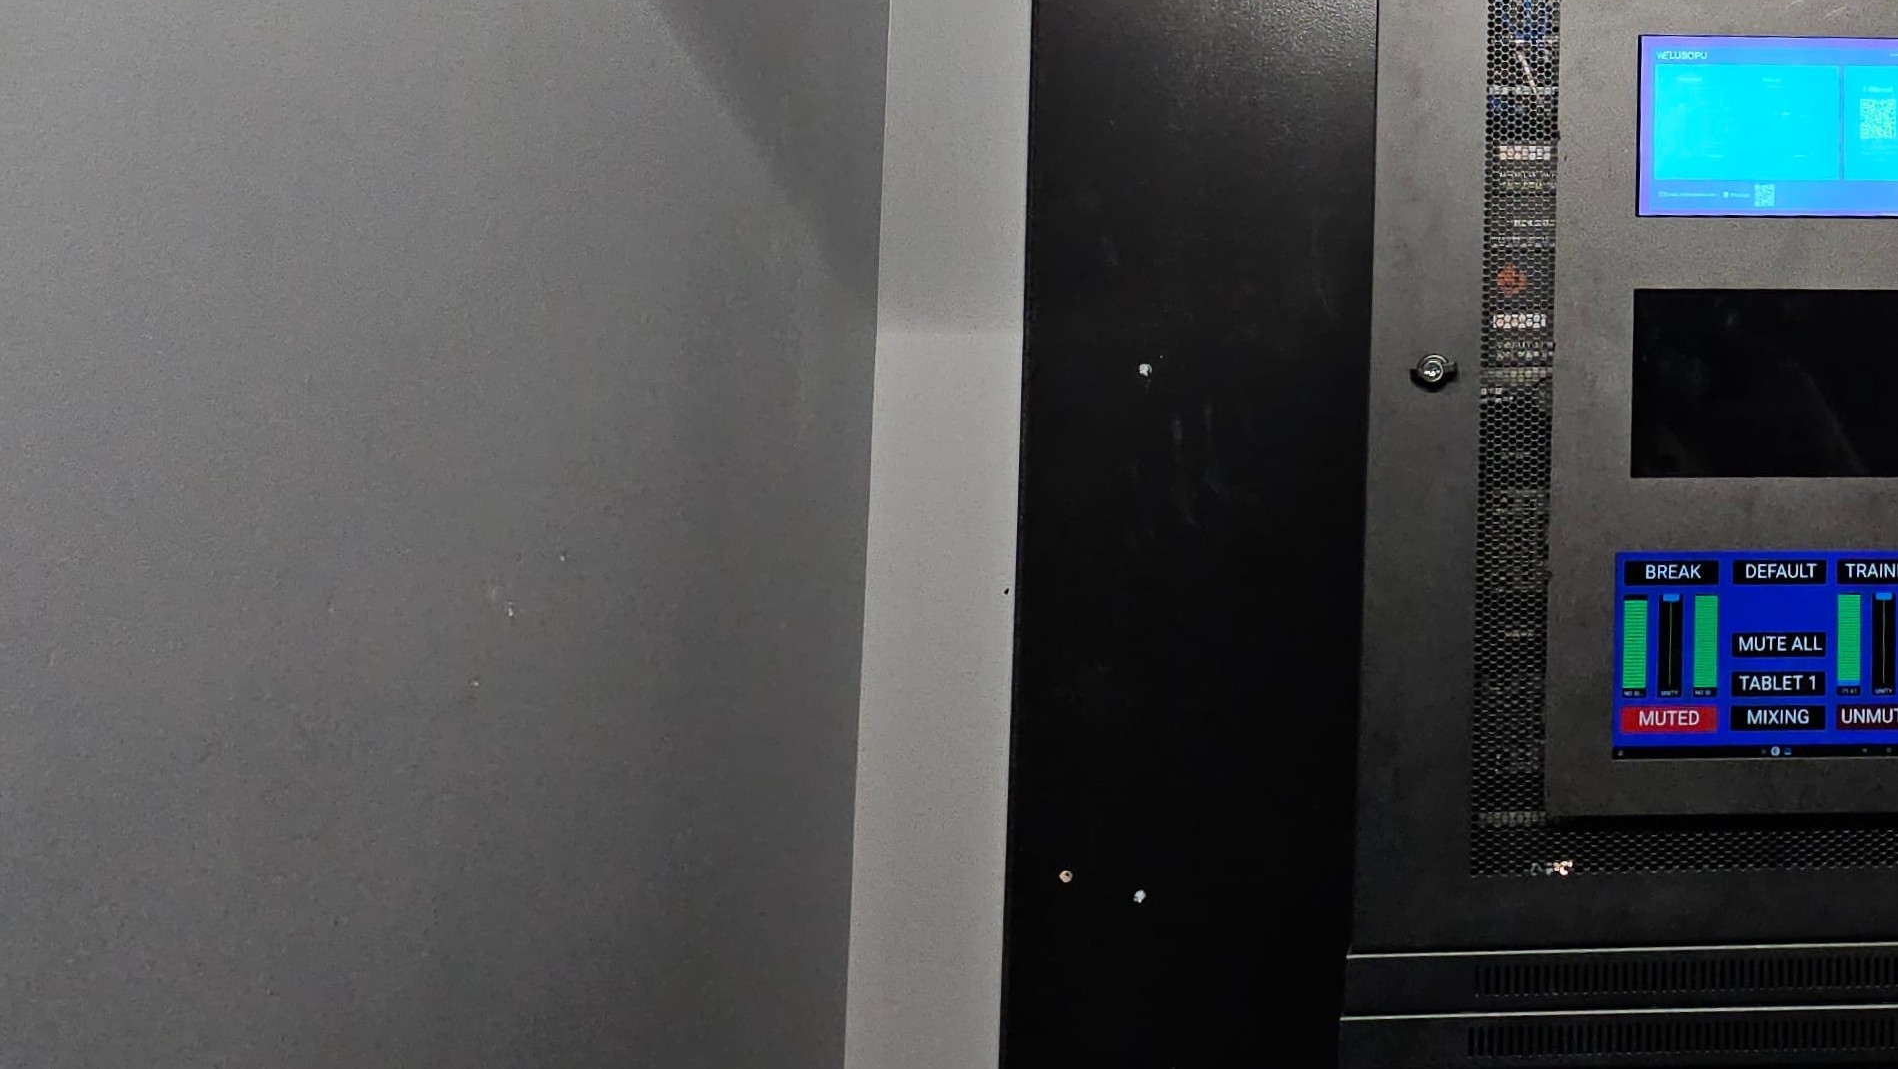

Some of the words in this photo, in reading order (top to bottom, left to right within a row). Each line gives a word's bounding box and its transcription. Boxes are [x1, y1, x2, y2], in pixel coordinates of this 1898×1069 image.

[1645, 564, 1702, 580] BREAK
[1745, 563, 1818, 579] DEFAULT
[1738, 635, 1787, 652] MUTE
[1791, 635, 1823, 651] ALL
[1739, 675, 1803, 691] TABLET
[1808, 675, 1817, 691] 1
[1638, 710, 1700, 726] MUTED
[1747, 709, 1810, 725] MIXING
